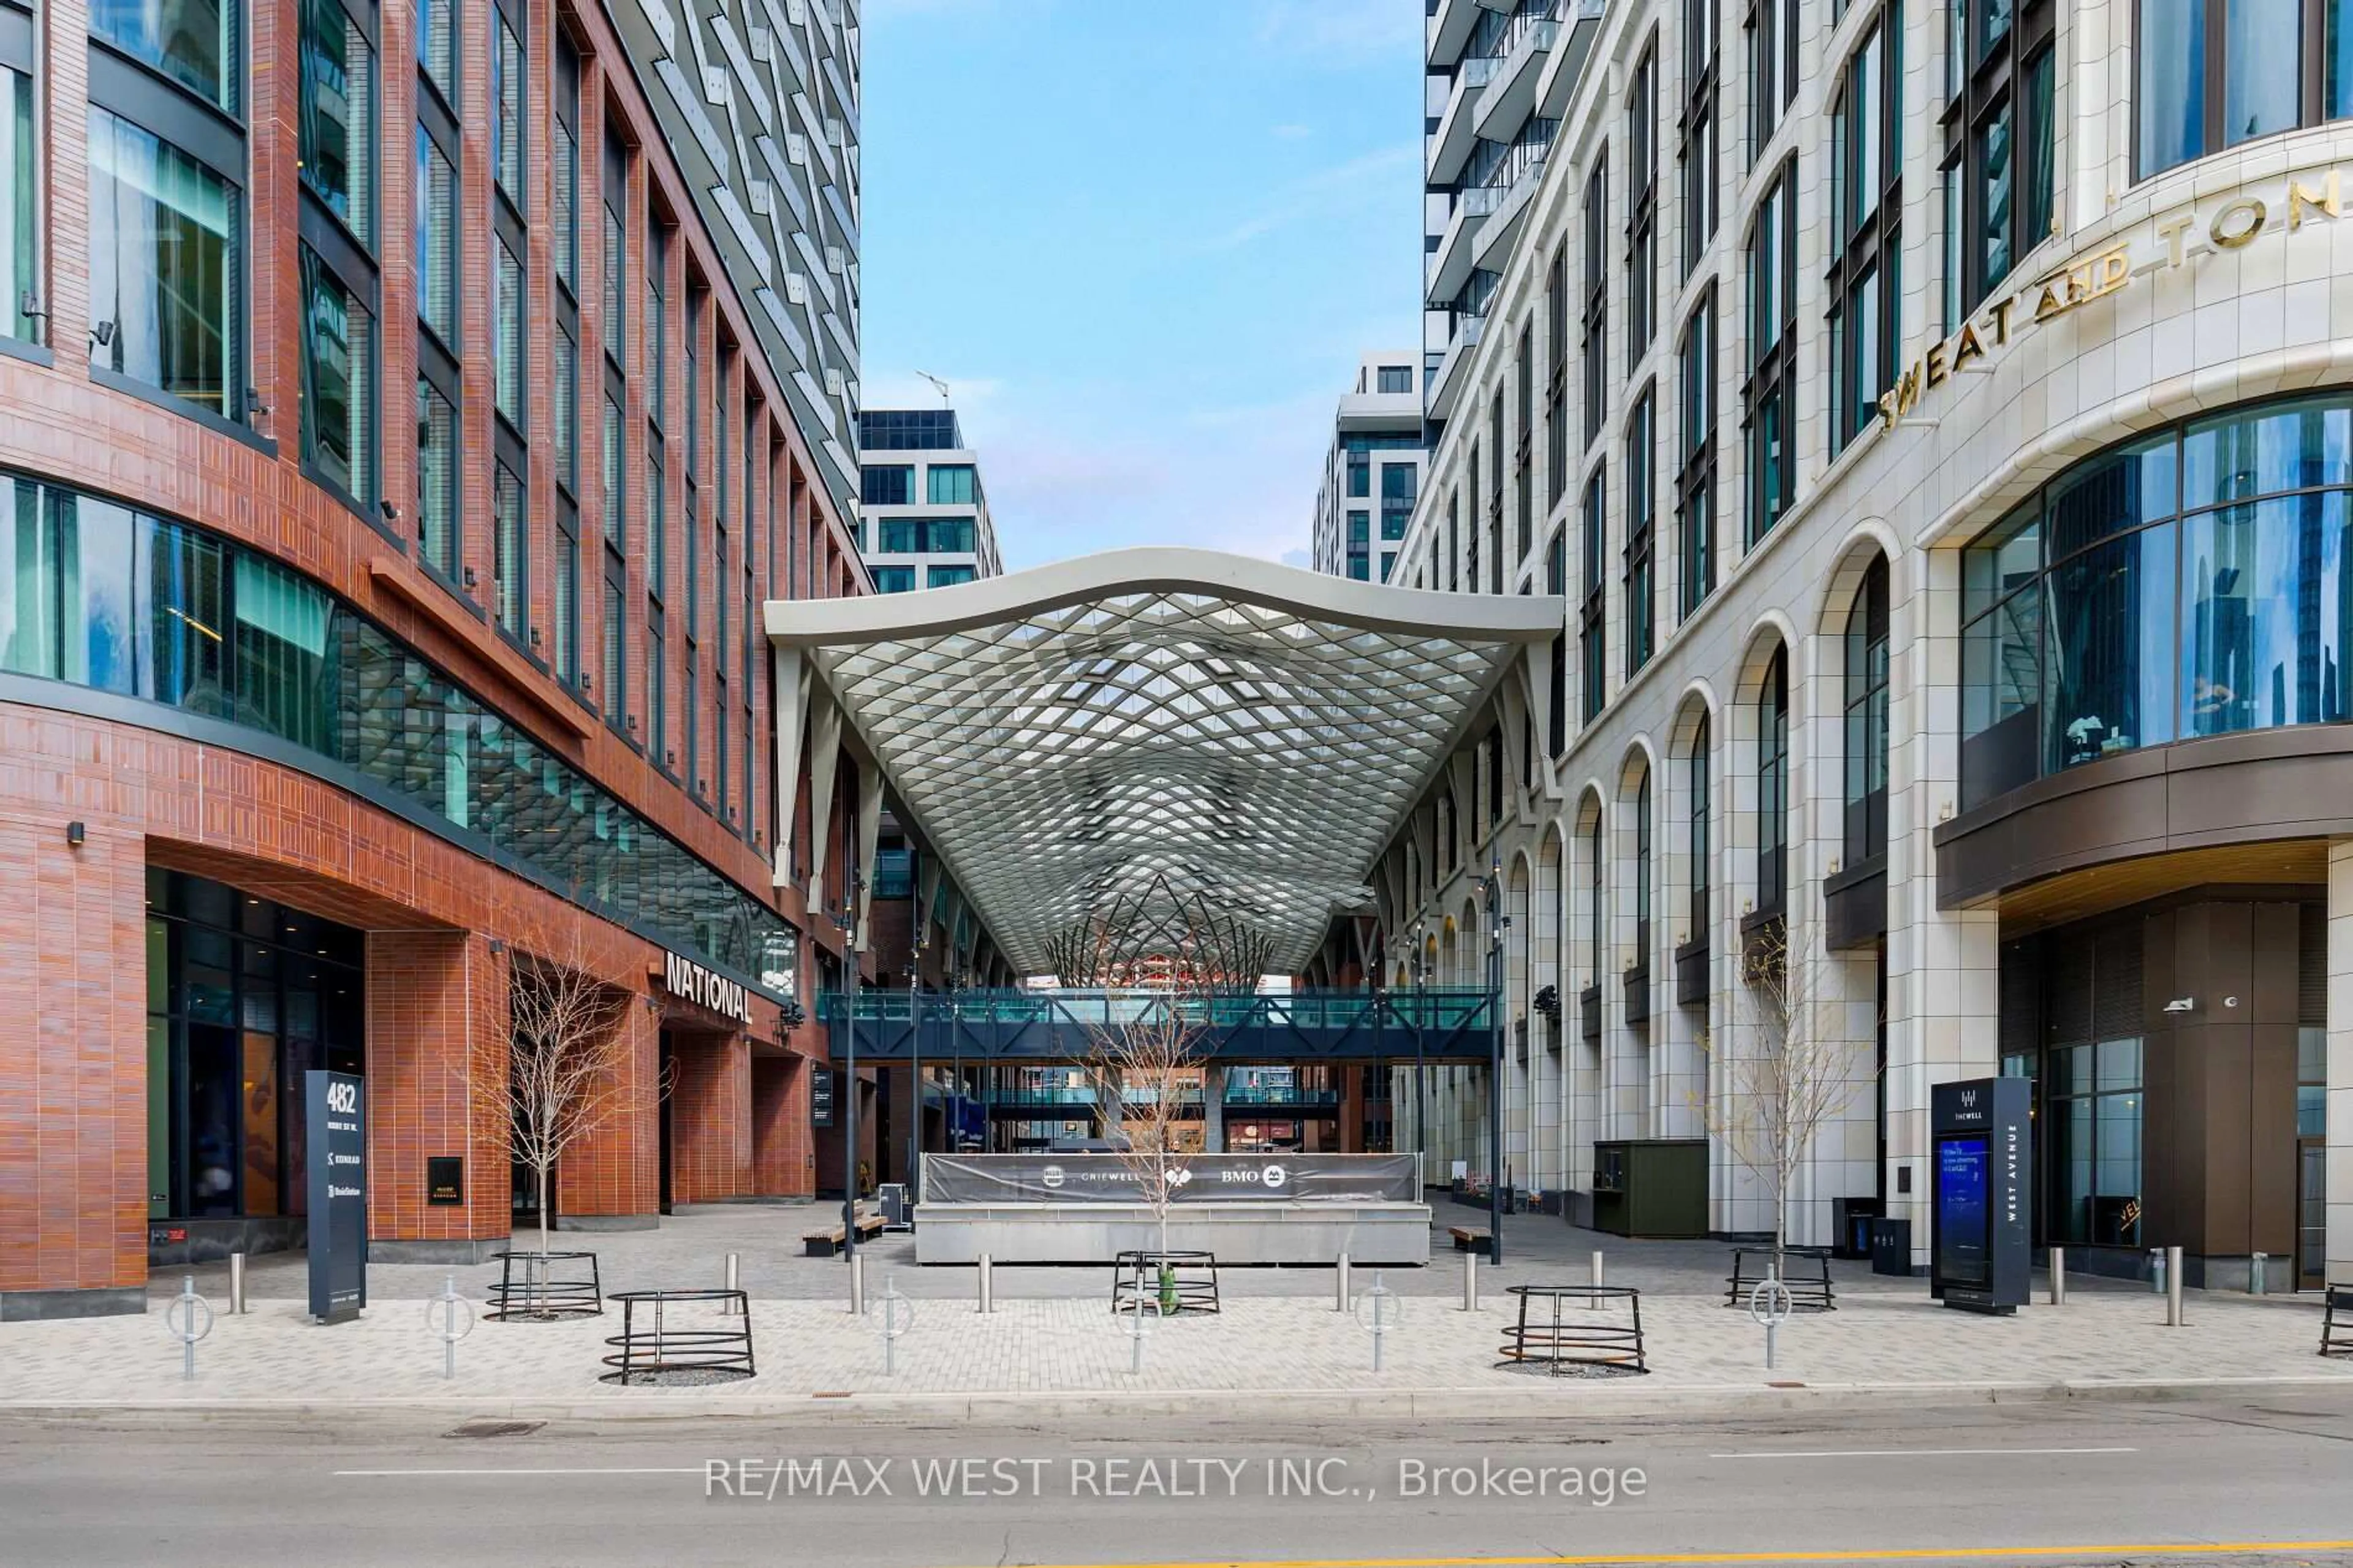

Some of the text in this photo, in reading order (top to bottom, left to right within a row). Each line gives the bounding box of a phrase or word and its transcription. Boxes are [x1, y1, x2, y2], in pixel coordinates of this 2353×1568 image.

[1879, 170, 2340, 433] SWEAT AND TON
[667, 951, 752, 1025] NATIONAL
[327, 1082, 356, 1113] 482
[1222, 1170, 1259, 1182] BMO
